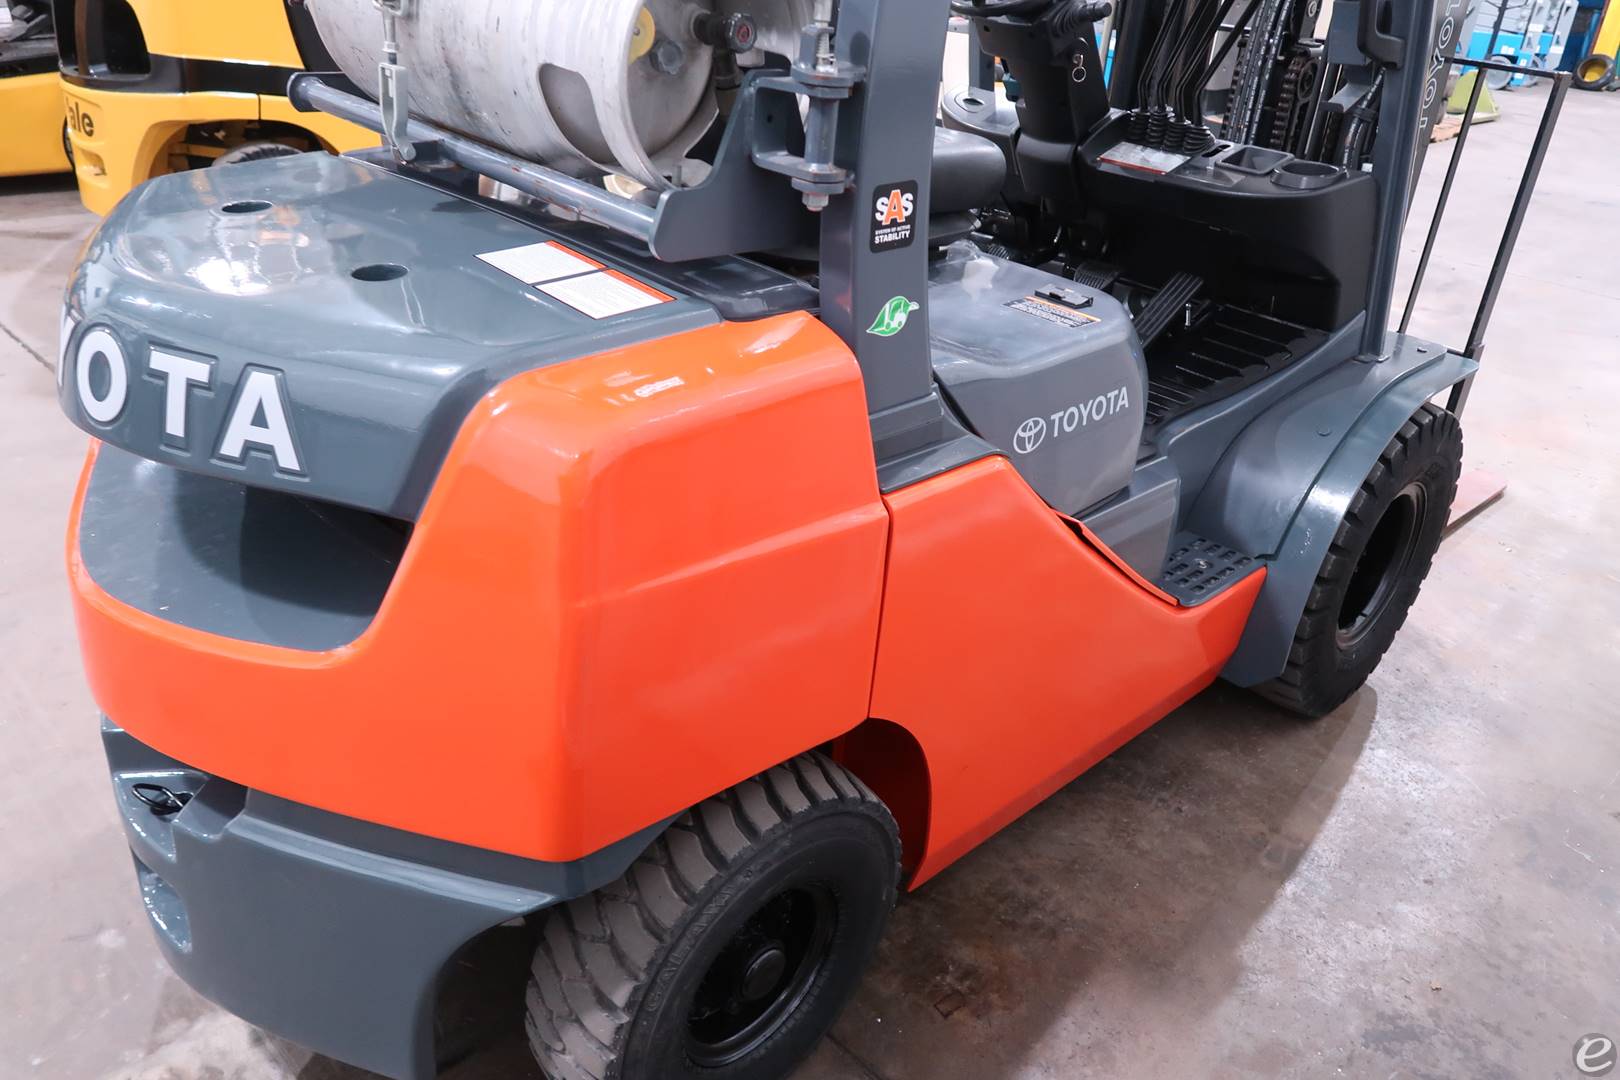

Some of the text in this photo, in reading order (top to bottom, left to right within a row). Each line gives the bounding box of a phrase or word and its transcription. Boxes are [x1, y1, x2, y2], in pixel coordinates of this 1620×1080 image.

[875, 189, 914, 225] SAS
[874, 230, 911, 244] STABILITY
[1050, 386, 1129, 438] TOYOTA
